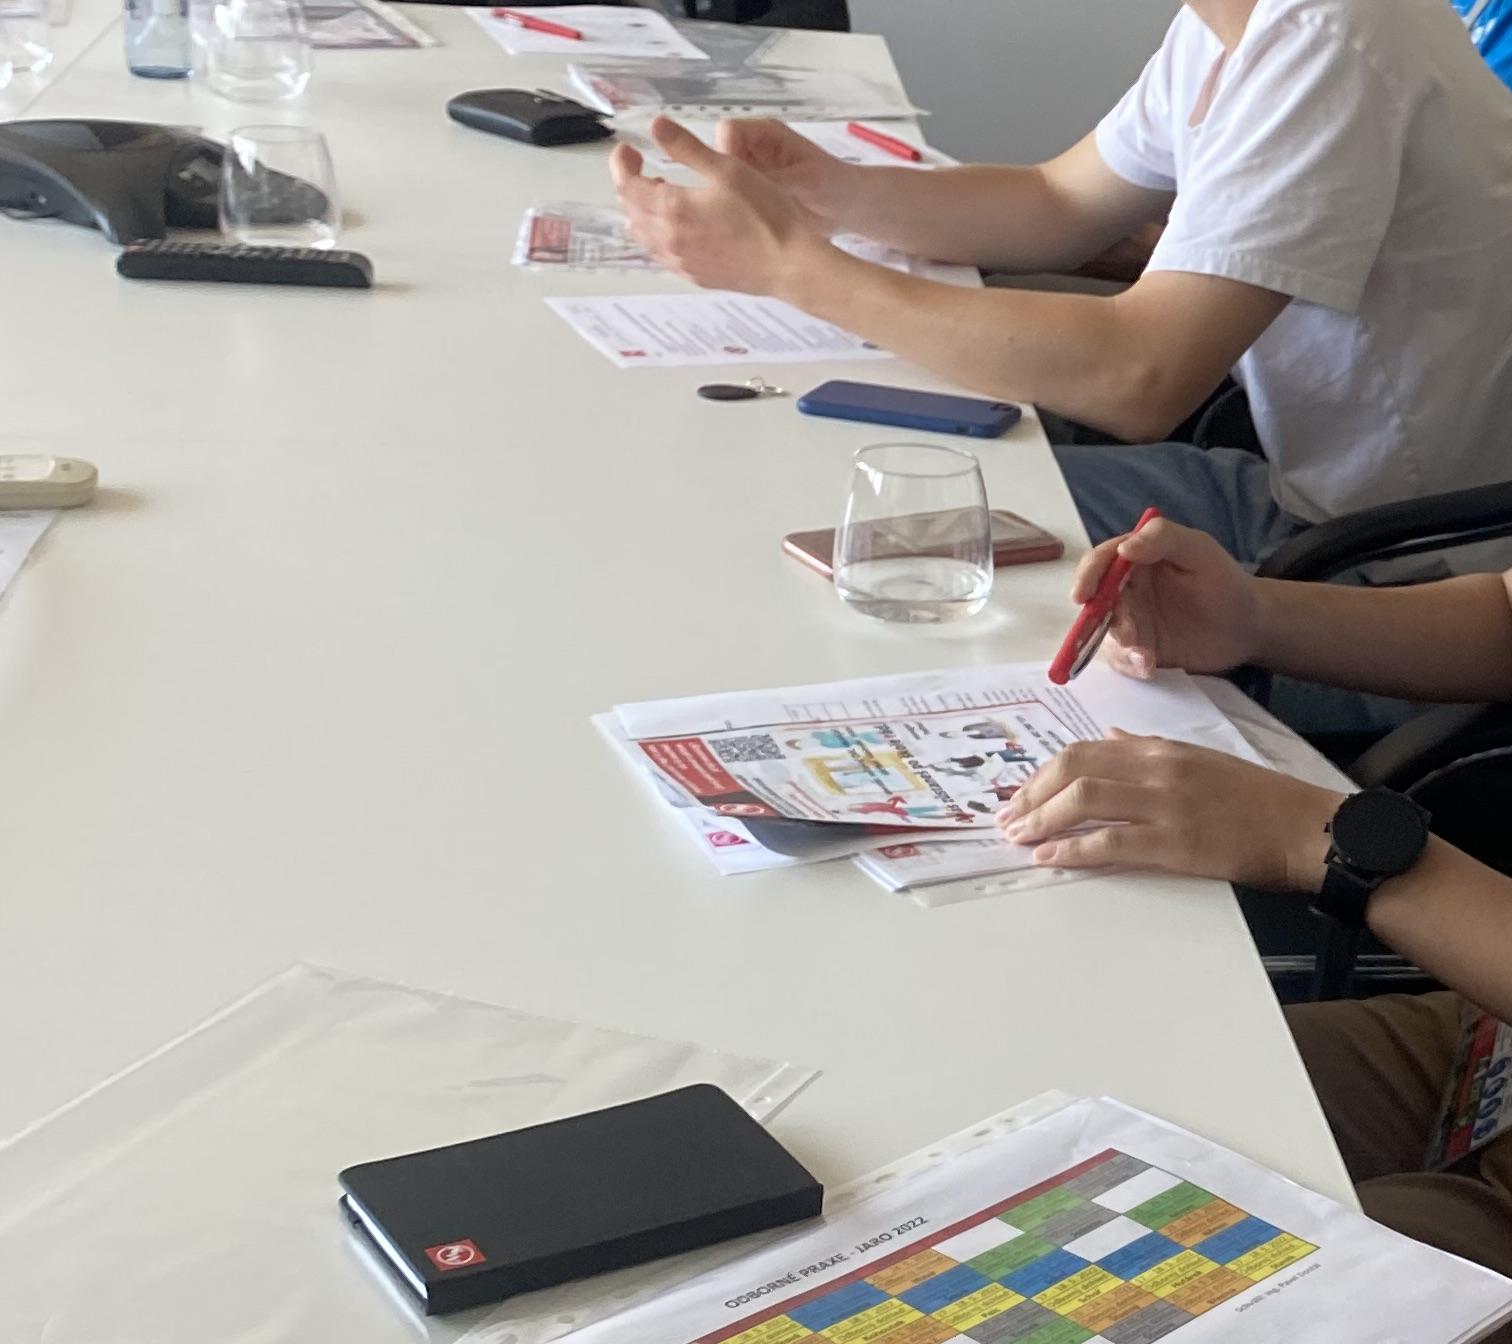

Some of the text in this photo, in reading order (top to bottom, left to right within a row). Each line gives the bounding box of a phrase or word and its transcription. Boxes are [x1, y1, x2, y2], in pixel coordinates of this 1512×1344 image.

[723, 1270, 802, 1309] ODBORNÉ
[797, 1251, 850, 1278] PRAXE
[853, 1231, 894, 1254] JARO
[890, 1215, 930, 1236] 2022
